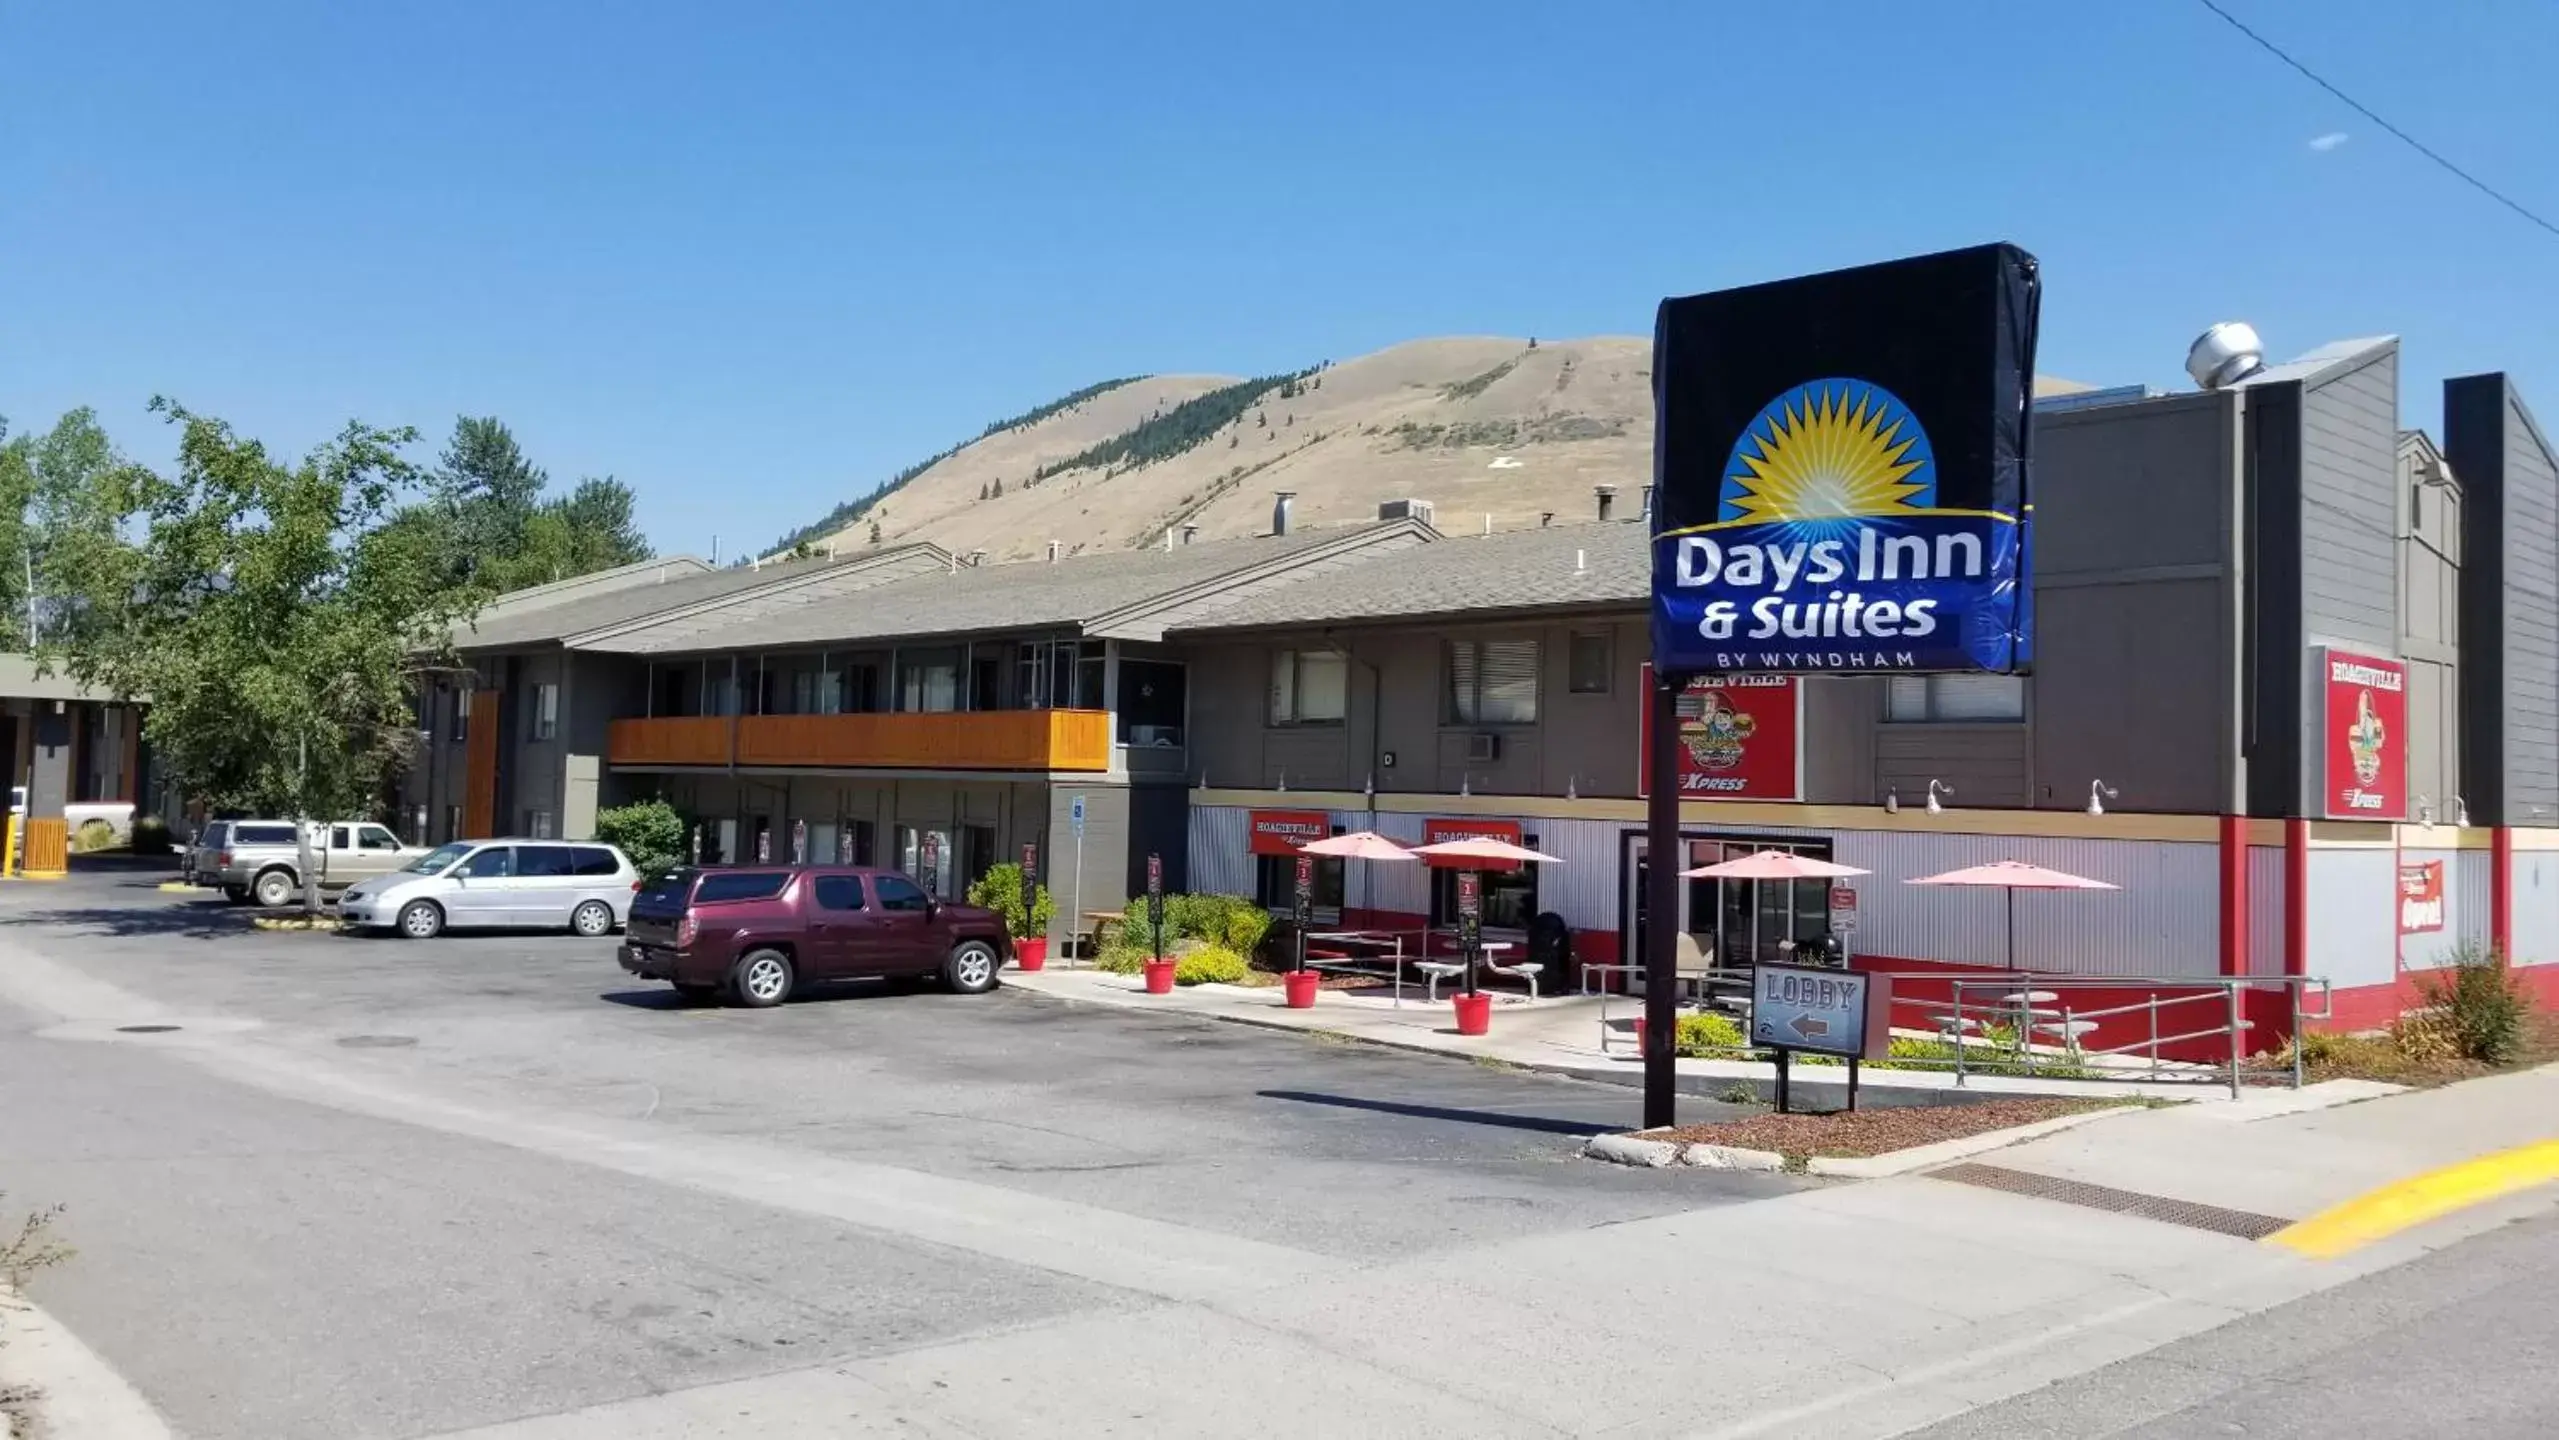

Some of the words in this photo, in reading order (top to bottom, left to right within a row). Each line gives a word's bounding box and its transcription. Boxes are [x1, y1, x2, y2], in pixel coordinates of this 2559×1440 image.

[1676, 536, 1844, 592] Days
[1858, 527, 1982, 581] Inn
[1700, 601, 1739, 639] &
[1748, 590, 1938, 639] Suites
[1717, 653, 1748, 668] BY
[1760, 651, 1915, 668] WYNDHAM
[1764, 973, 1857, 1010] LOBBY
